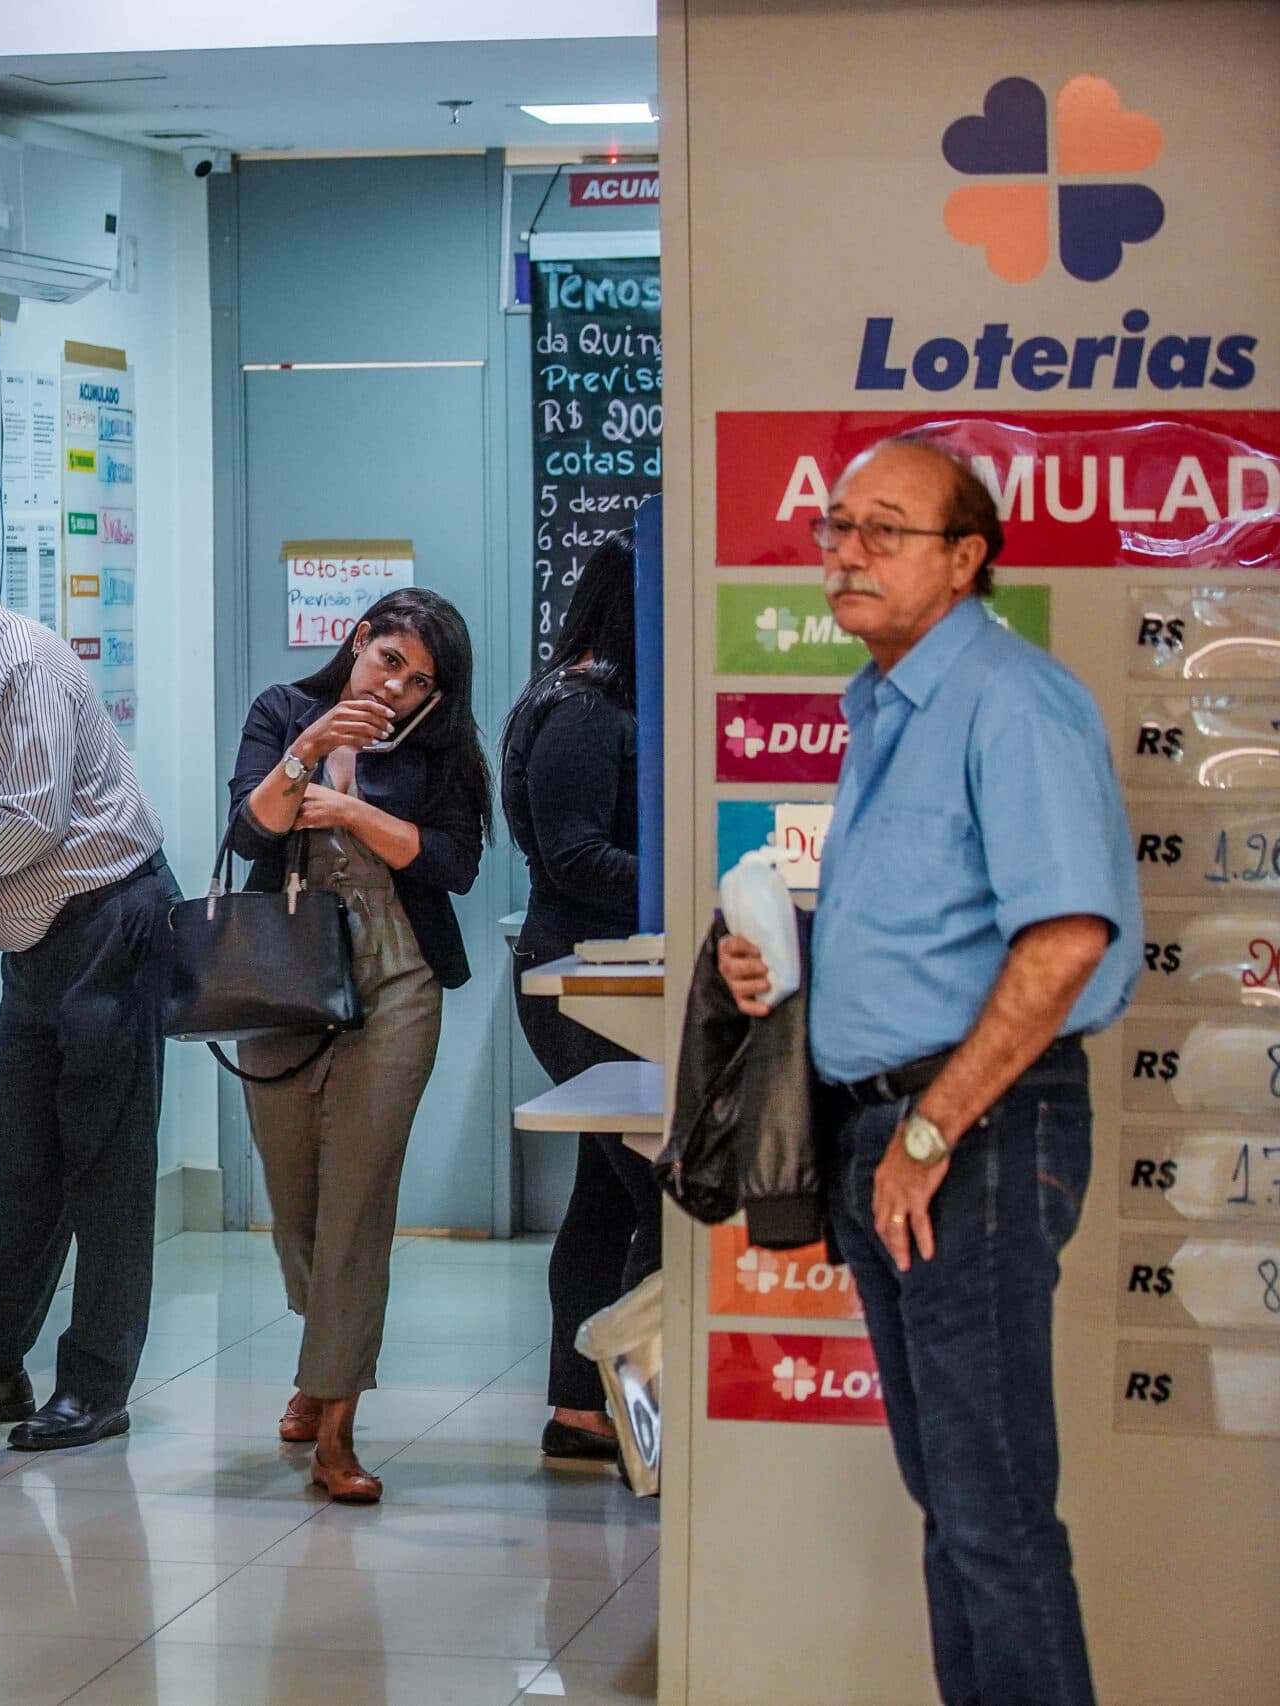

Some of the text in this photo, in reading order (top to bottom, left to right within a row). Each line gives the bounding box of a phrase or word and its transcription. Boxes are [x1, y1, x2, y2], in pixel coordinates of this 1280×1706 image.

[582, 179, 659, 200] ACUM
[536, 322, 662, 357] da Quin
[855, 309, 1257, 391] Loterias
[79, 384, 119, 404] ACUMULADO
[538, 399, 582, 433] R$
[546, 440, 635, 476] cotas
[540, 485, 558, 517] 5
[776, 456, 1280, 521] AMULAD
[538, 522, 552, 551] 6
[535, 560, 553, 591] 7
[540, 601, 551, 634] 8
[1137, 834, 1183, 866] R$
[1144, 943, 1182, 975] R$
[1133, 1050, 1179, 1082] R$
[1131, 1159, 1177, 1191] R$
[1128, 1259, 1280, 1313] R$ 8
[1125, 1372, 1172, 1405] R$
